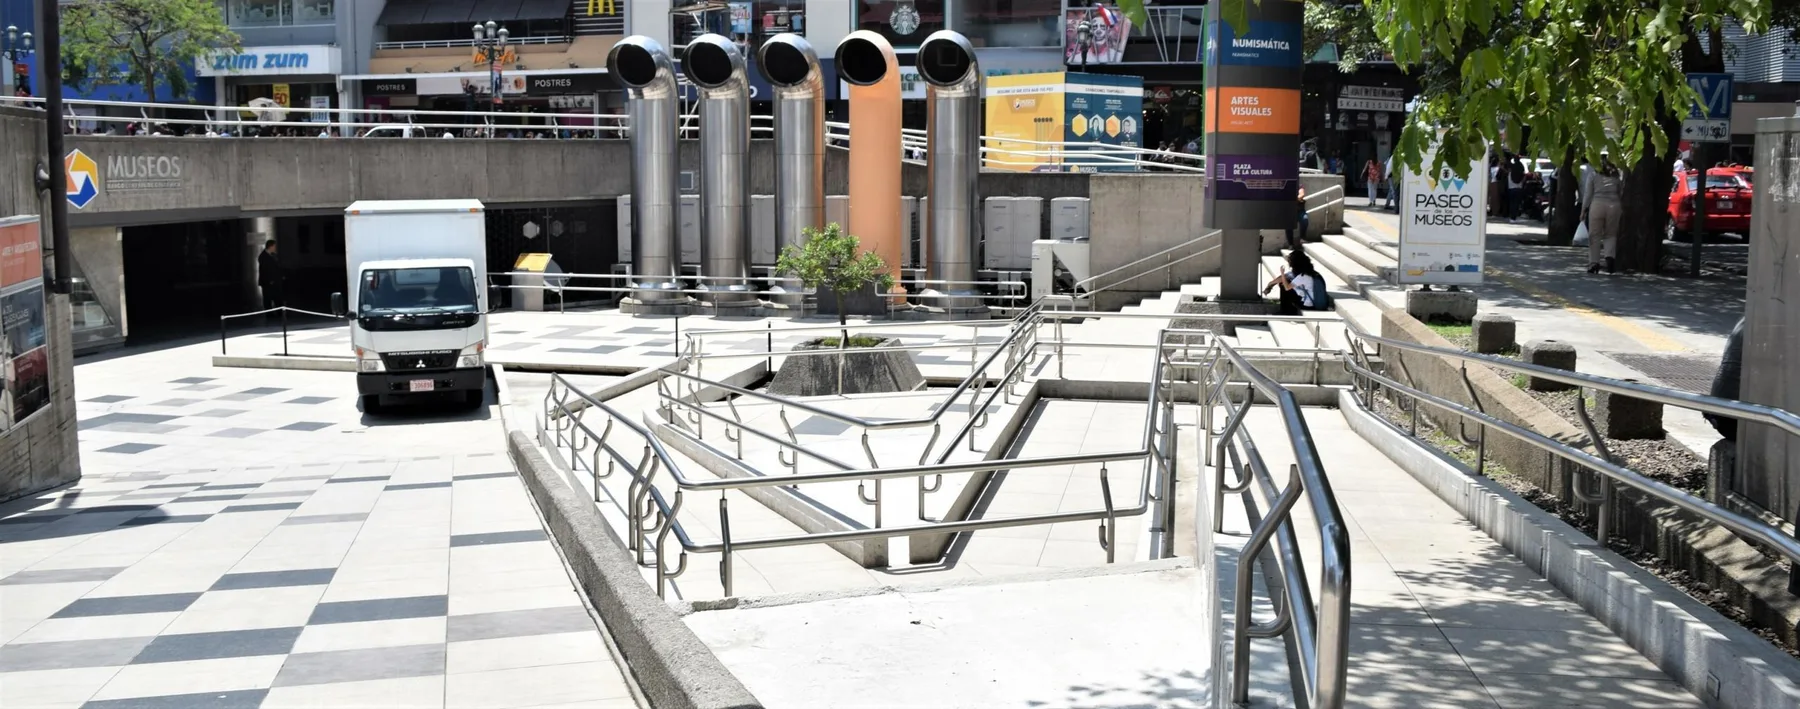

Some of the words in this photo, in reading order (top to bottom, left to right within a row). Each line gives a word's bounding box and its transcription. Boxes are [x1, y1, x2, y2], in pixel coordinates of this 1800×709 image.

[1232, 38, 1290, 51] NUMISMÁTICA
[213, 54, 258, 70] zum
[263, 52, 309, 68] zum
[534, 78, 572, 87] POSTRES
[1230, 96, 1259, 105] ARTES
[1230, 107, 1272, 116] VISUALES
[1696, 125, 1727, 138] MUSO
[107, 155, 181, 178] MUSEOS
[1415, 194, 1473, 208] PASEO
[1415, 214, 1472, 226] MUSEOS
